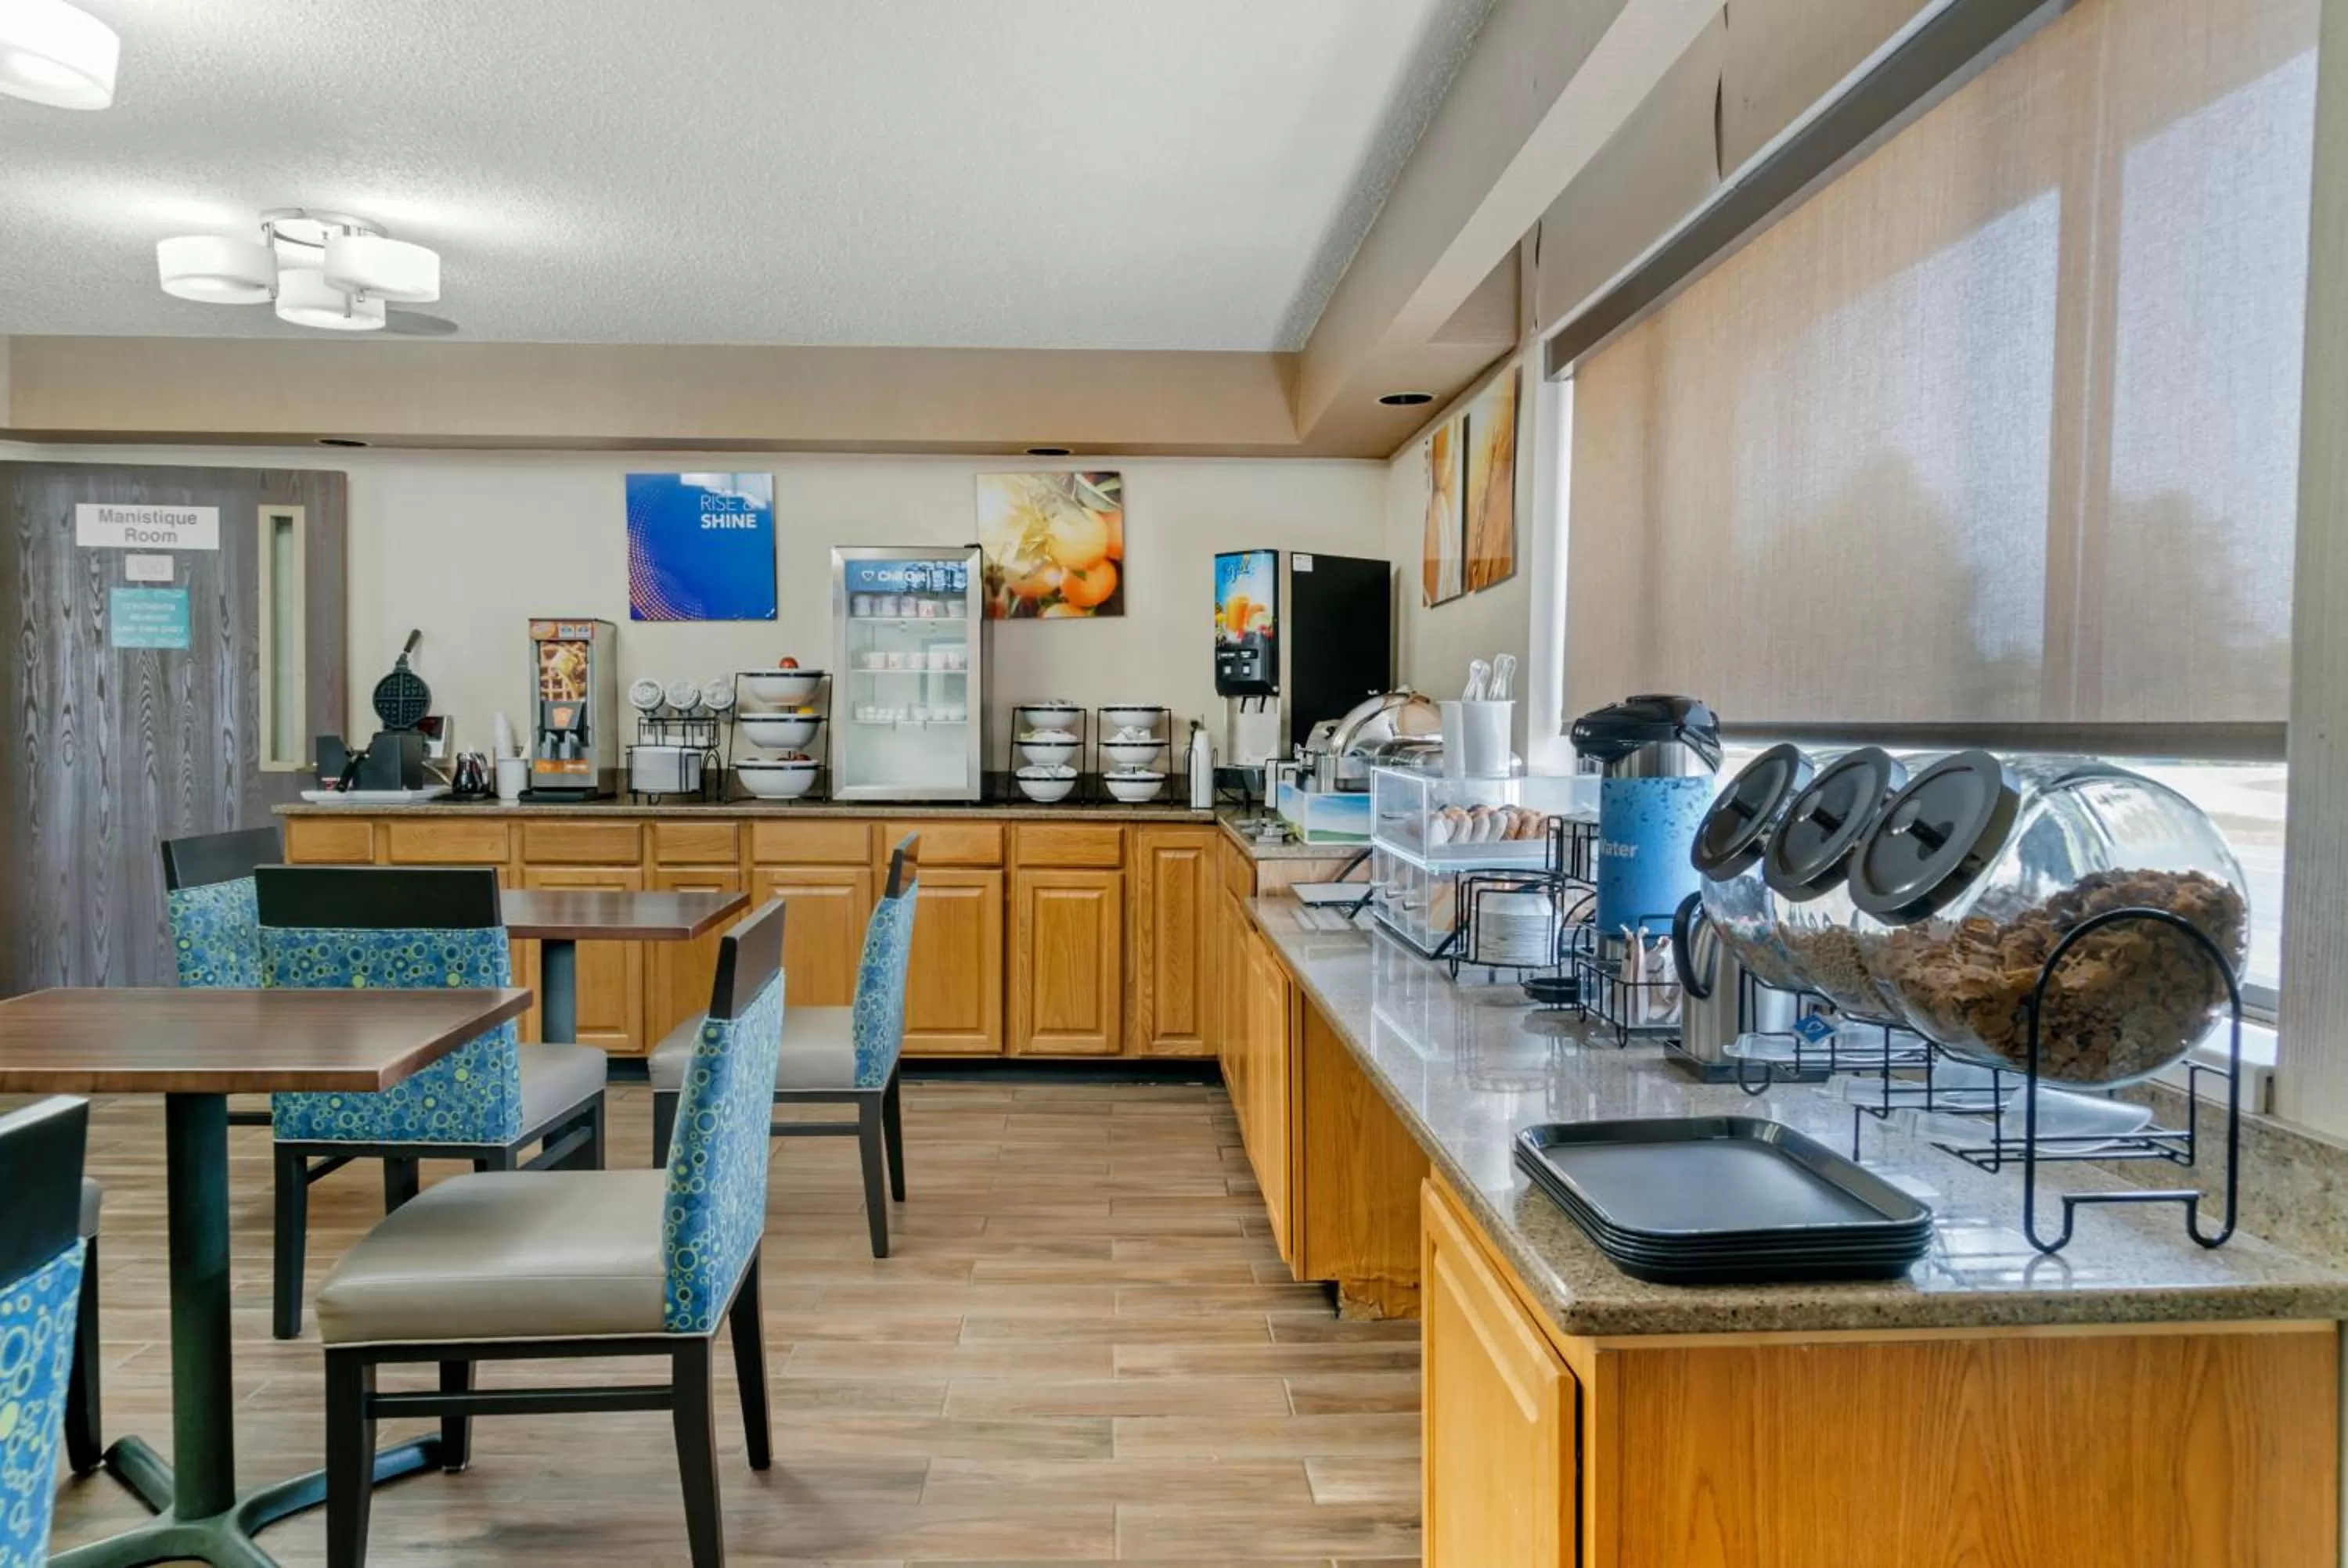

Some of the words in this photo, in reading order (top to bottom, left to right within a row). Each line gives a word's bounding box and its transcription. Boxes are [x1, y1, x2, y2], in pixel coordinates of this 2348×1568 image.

[700, 494, 736, 511] RISE
[99, 509, 198, 528] Manistique
[700, 513, 758, 529] SHINE
[124, 527, 178, 542] Room
